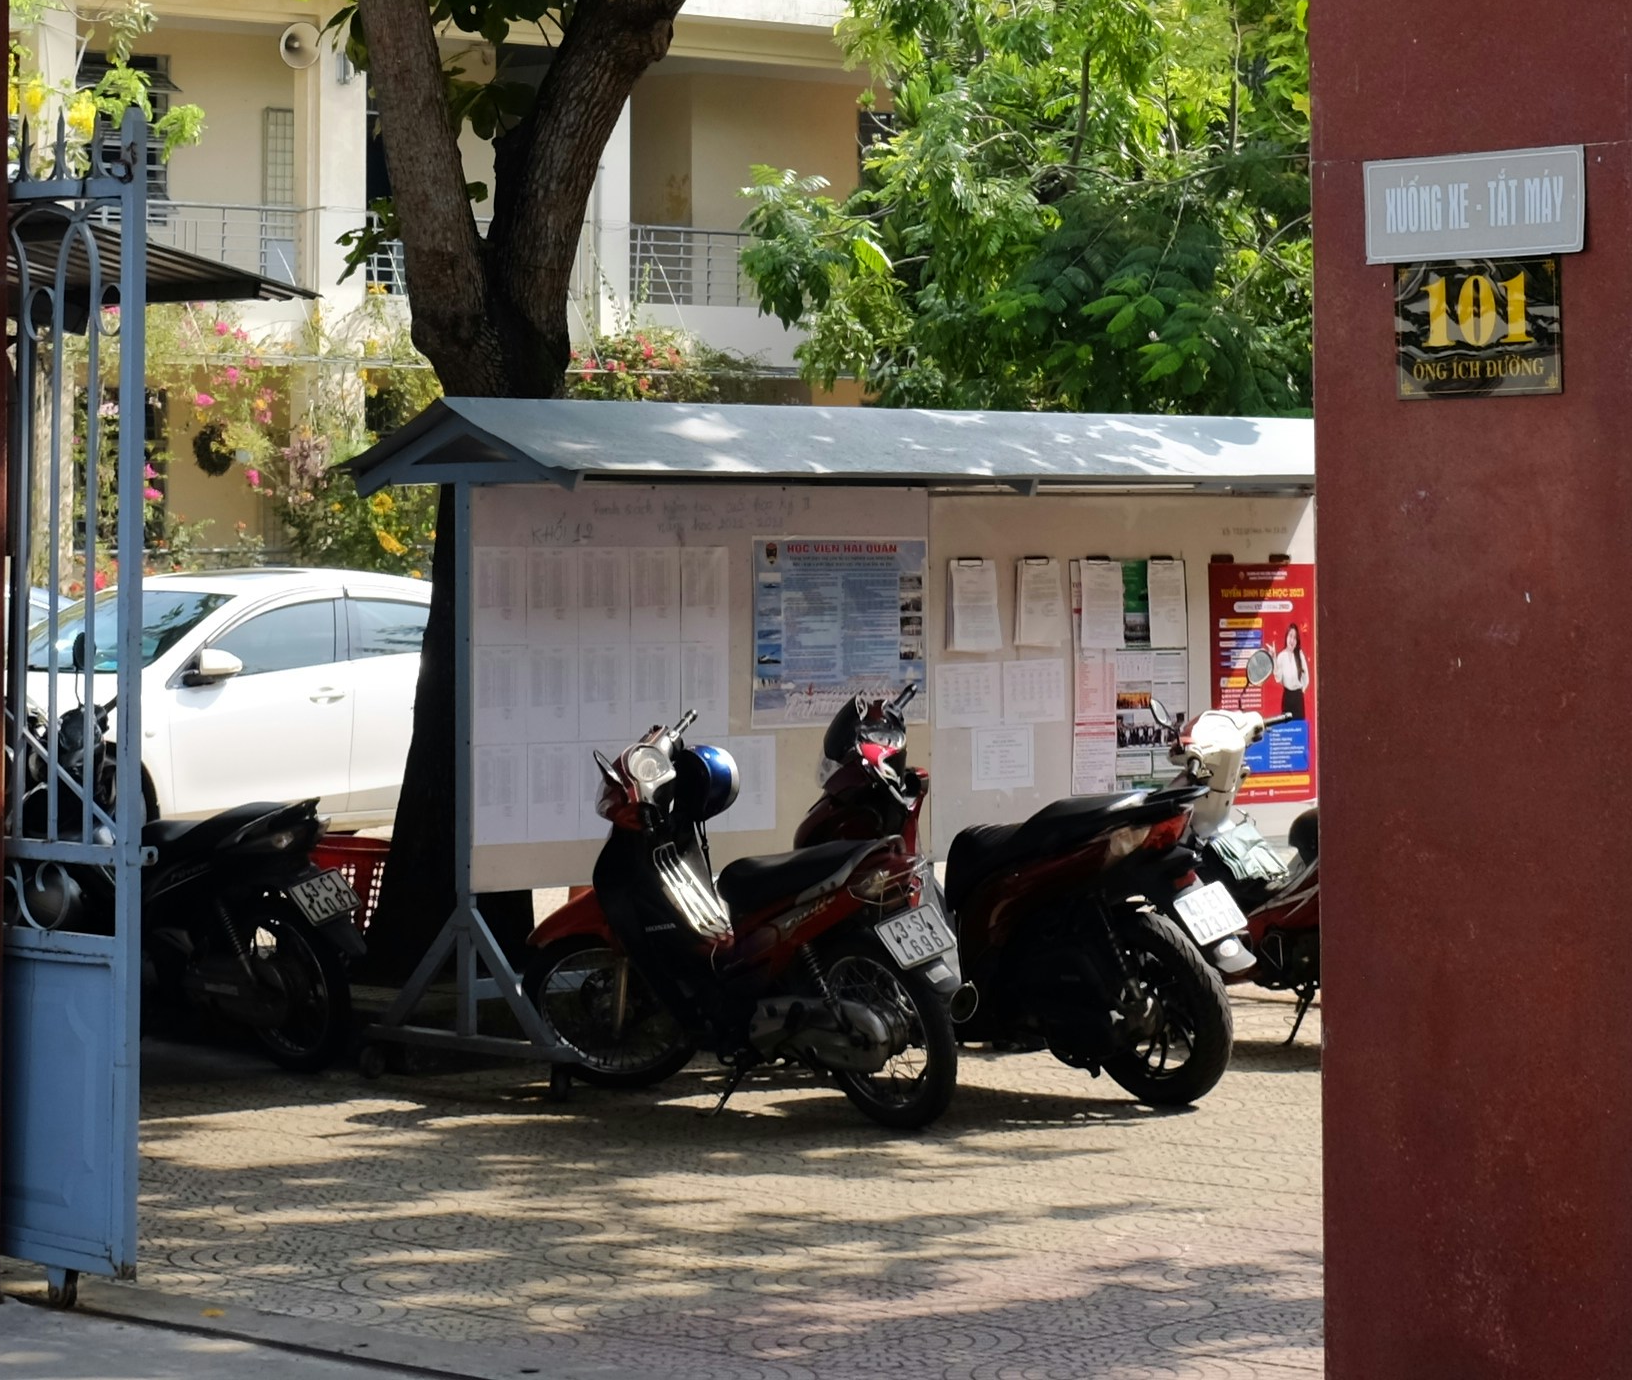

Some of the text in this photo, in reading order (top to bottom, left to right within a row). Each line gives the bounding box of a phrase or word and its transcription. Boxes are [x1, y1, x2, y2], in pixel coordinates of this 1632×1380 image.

[1385, 174, 1443, 234] XUỐNG
[1448, 182, 1470, 230] XE
[1487, 168, 1518, 227] TẮT
[1523, 170, 1564, 225] MÁY
[1420, 270, 1534, 348] 101
[1413, 353, 1545, 381] ÔNG ÍCH ĐƯỜNG
